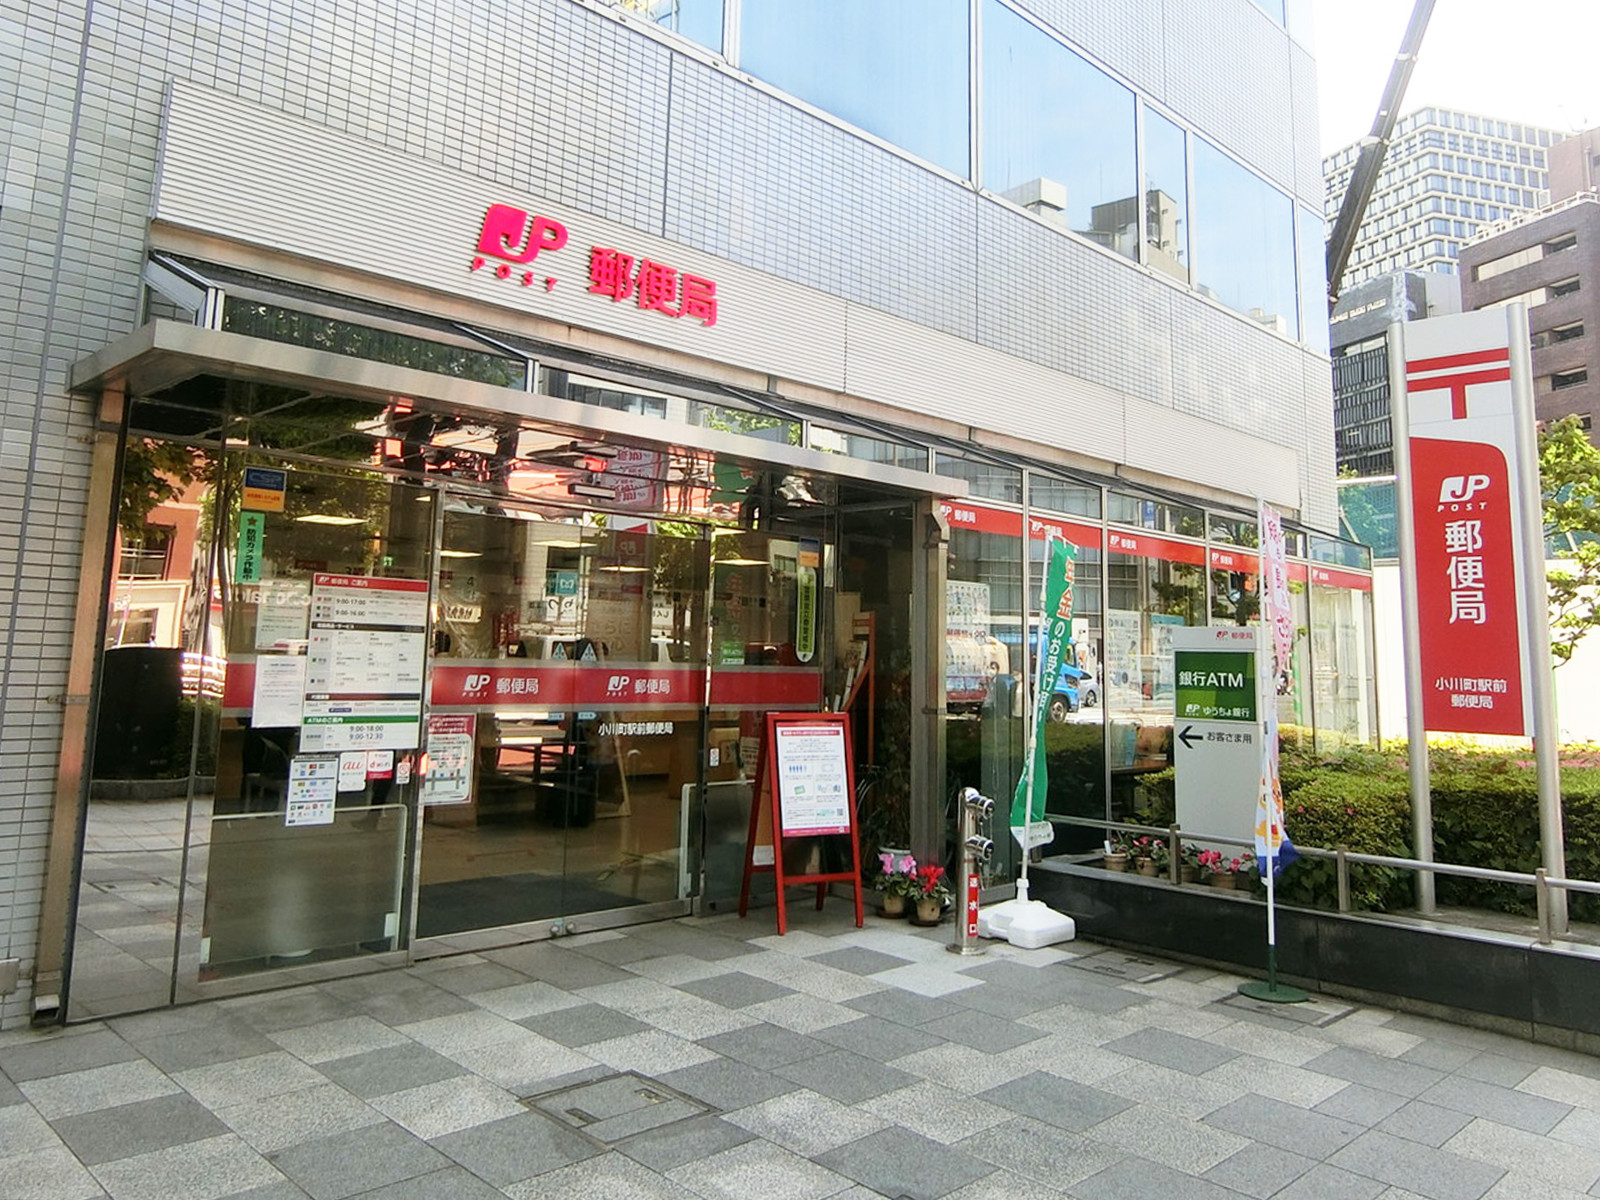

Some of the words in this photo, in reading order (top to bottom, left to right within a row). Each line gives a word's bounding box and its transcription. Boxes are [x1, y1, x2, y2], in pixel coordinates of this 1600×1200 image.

[477, 203, 568, 264] JP
[588, 246, 718, 327] 郵便局
[470, 255, 558, 292] POST
[1440, 474, 1490, 502] JP
[1437, 502, 1487, 512] POST
[954, 509, 976, 523] 郵便局
[1445, 520, 1487, 625] 郵便局
[1231, 631, 1253, 640] 郵便局
[464, 675, 491, 692] JP
[496, 678, 539, 694] 郵便局
[608, 675, 630, 691] JP
[635, 679, 671, 694] 郵便局
[1179, 671, 1243, 688] 銀行ATM
[1435, 677, 1507, 693] 小川町駅前
[1451, 694, 1493, 709] 郵便局
[1203, 706, 1250, 718] ゆうちょ銀行
[598, 722, 674, 736] 小川町駅前郵便局
[1207, 731, 1252, 745] お客さま用
[342, 762, 362, 770] au
